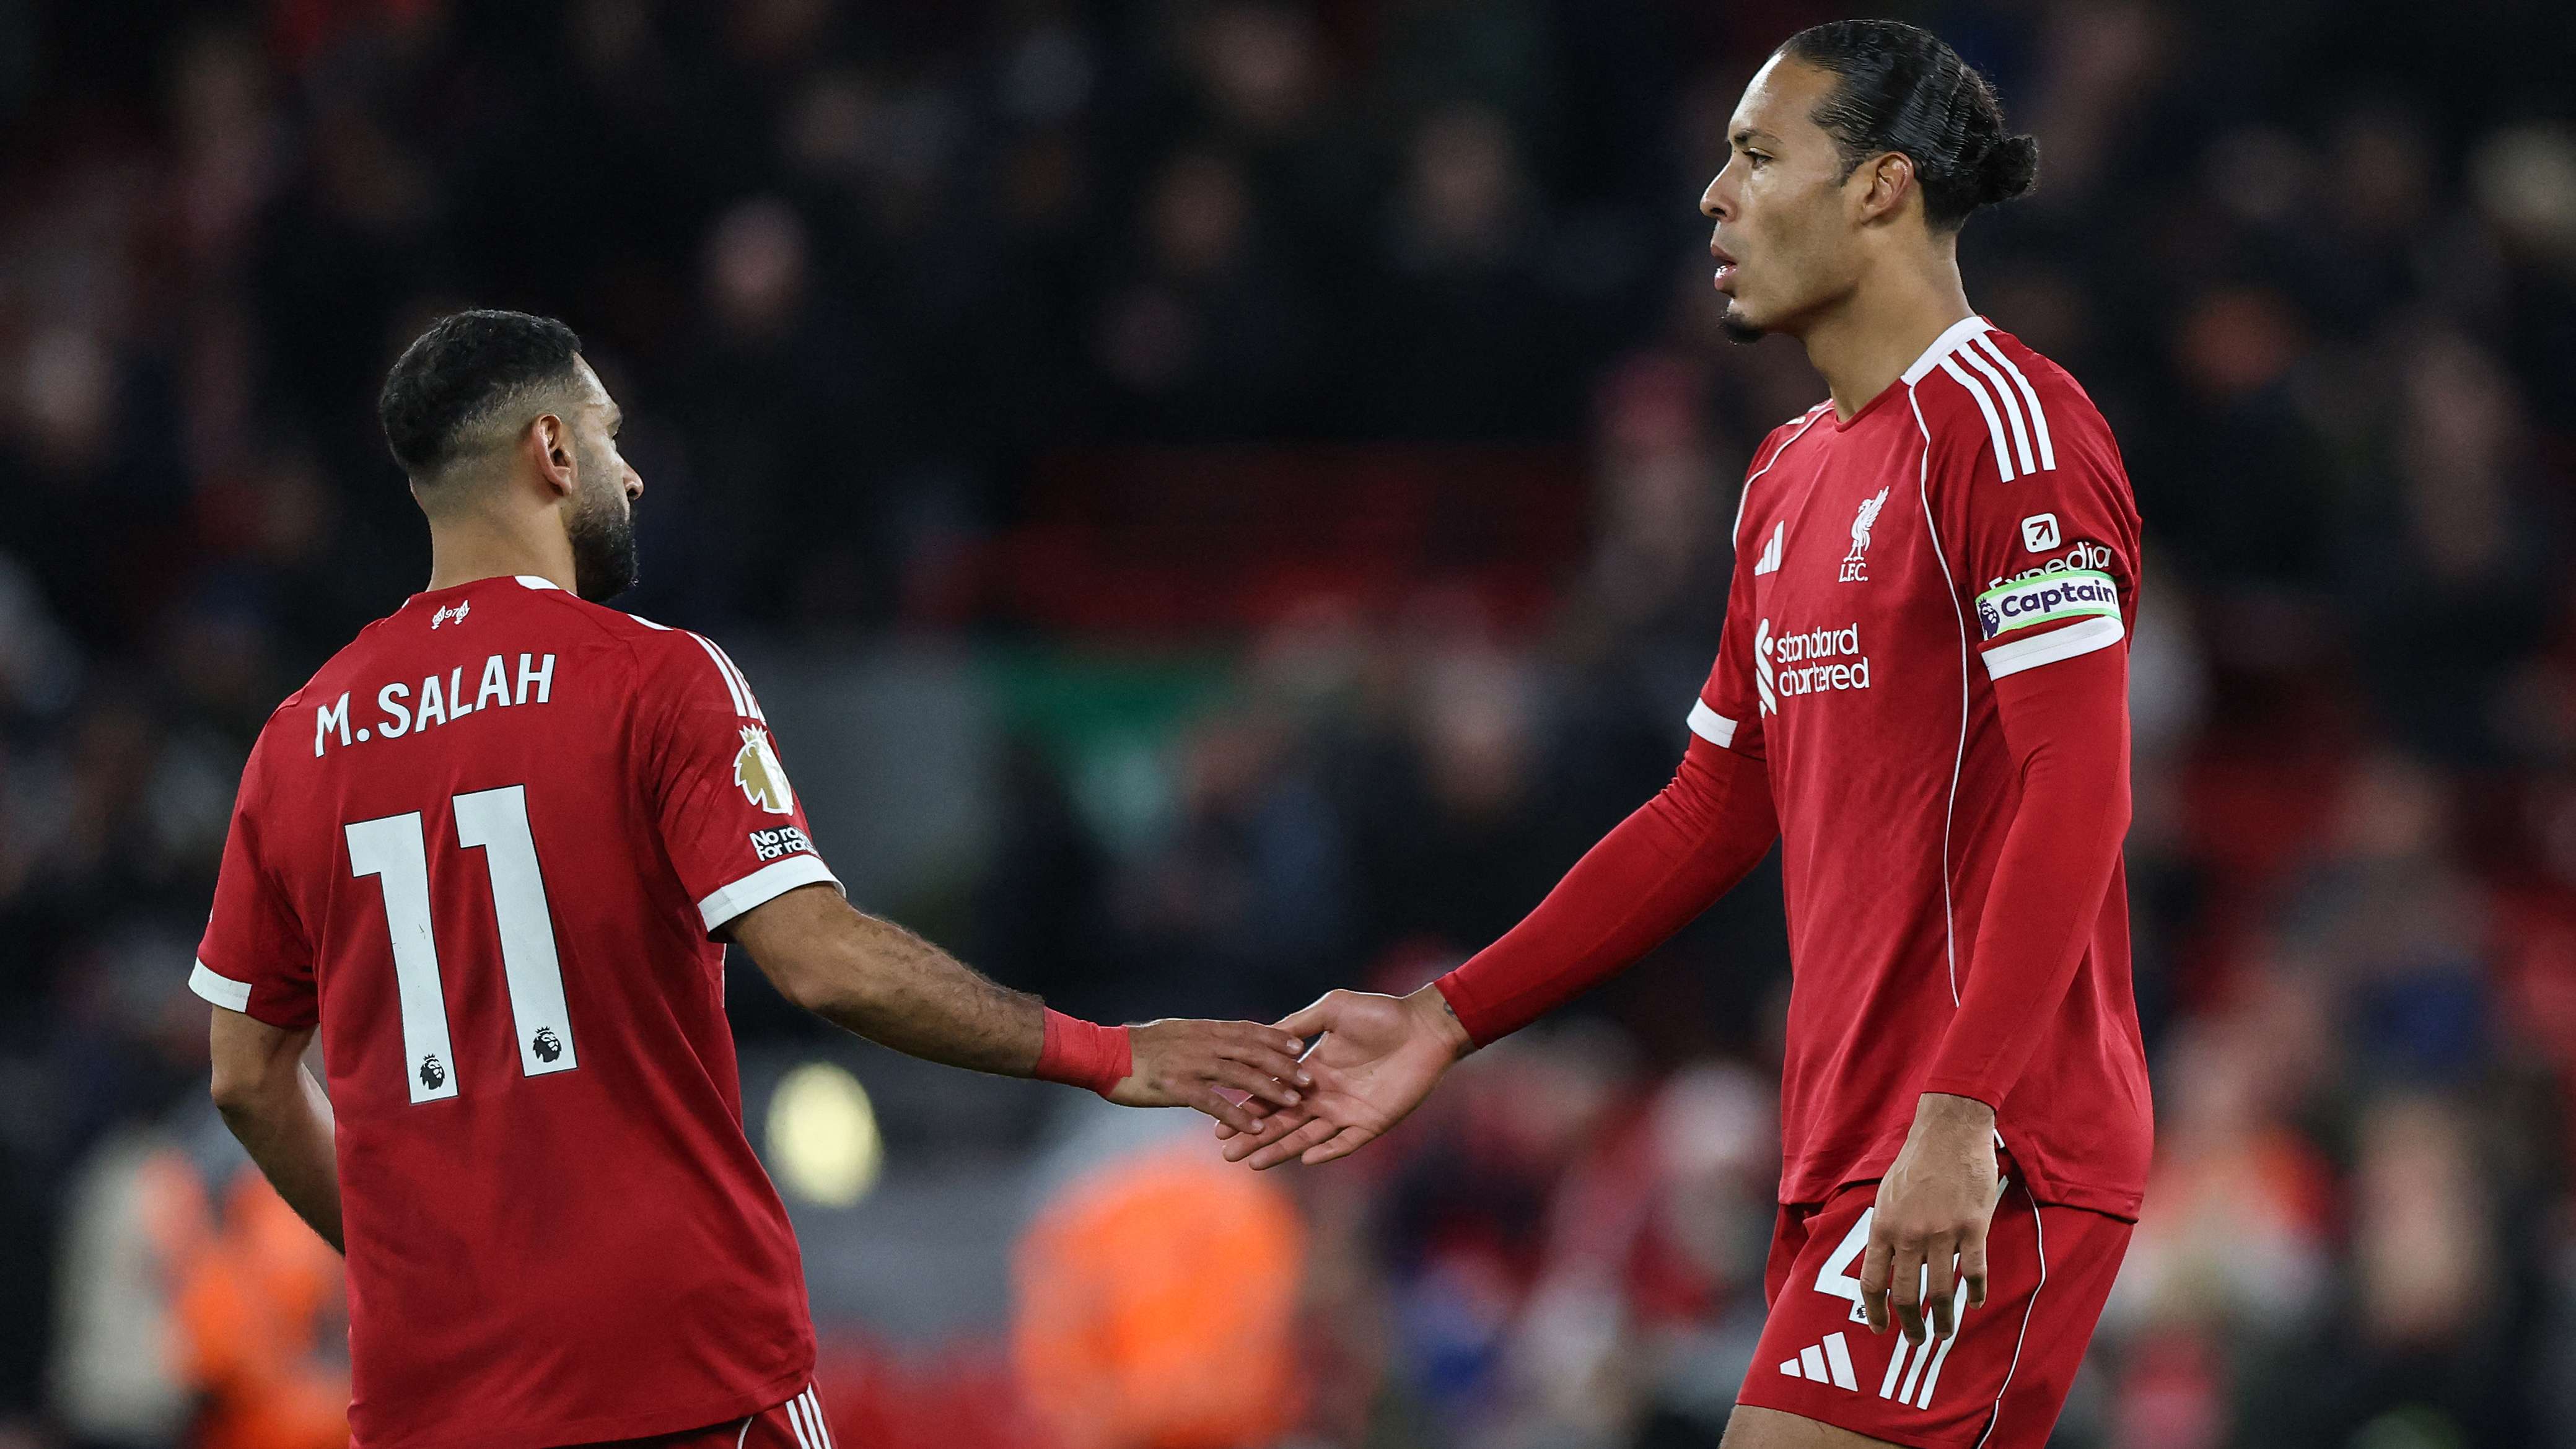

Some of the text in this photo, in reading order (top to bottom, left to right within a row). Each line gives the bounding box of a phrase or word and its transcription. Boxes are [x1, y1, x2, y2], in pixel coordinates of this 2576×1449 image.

[1989, 541, 2112, 589] edia
[444, 607, 460, 618] 97
[2001, 579, 2116, 617] Captain
[1776, 622, 1859, 663] standard
[1779, 656, 1870, 697] chartered
[314, 653, 556, 759] M.SALAH
[749, 830, 779, 846] No
[756, 843, 784, 862] for
[343, 784, 579, 1105] 11
